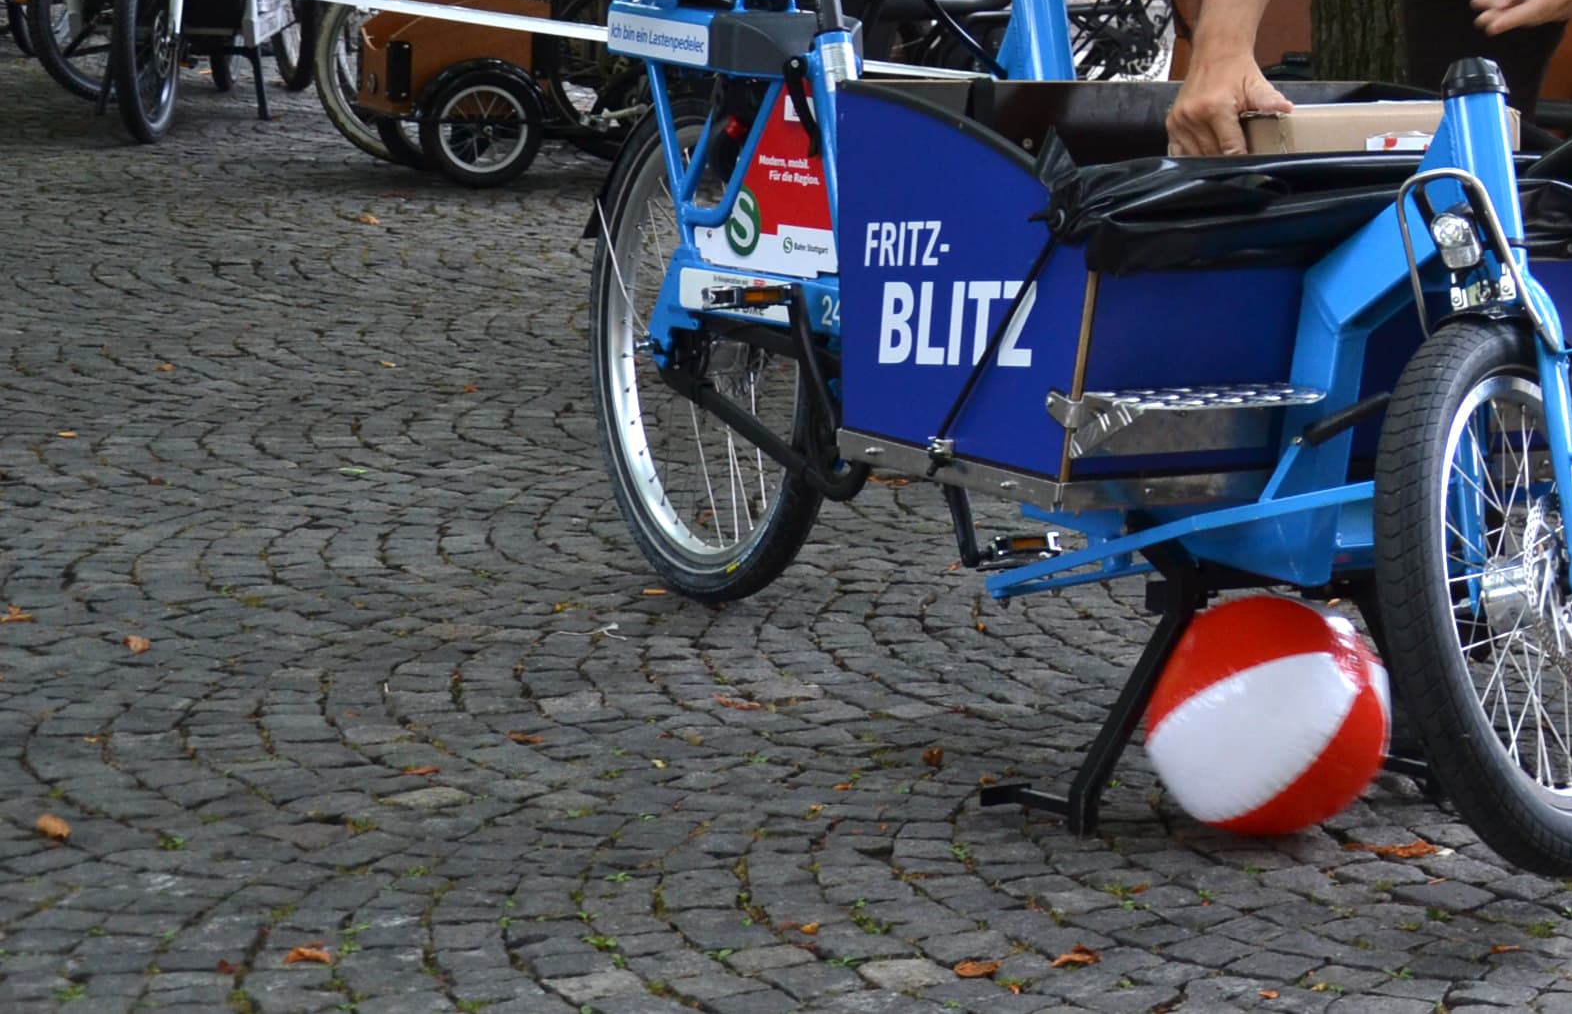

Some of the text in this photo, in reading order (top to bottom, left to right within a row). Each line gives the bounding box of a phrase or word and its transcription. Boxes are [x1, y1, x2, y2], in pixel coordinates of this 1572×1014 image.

[610, 22, 705, 53] Ich bin ein Lastenpedelec
[759, 154, 787, 168] Modern,
[769, 170, 820, 186] Für die Region.
[730, 190, 755, 248] S
[864, 220, 950, 267] FRITZ-
[877, 280, 1038, 368] BLITZ
